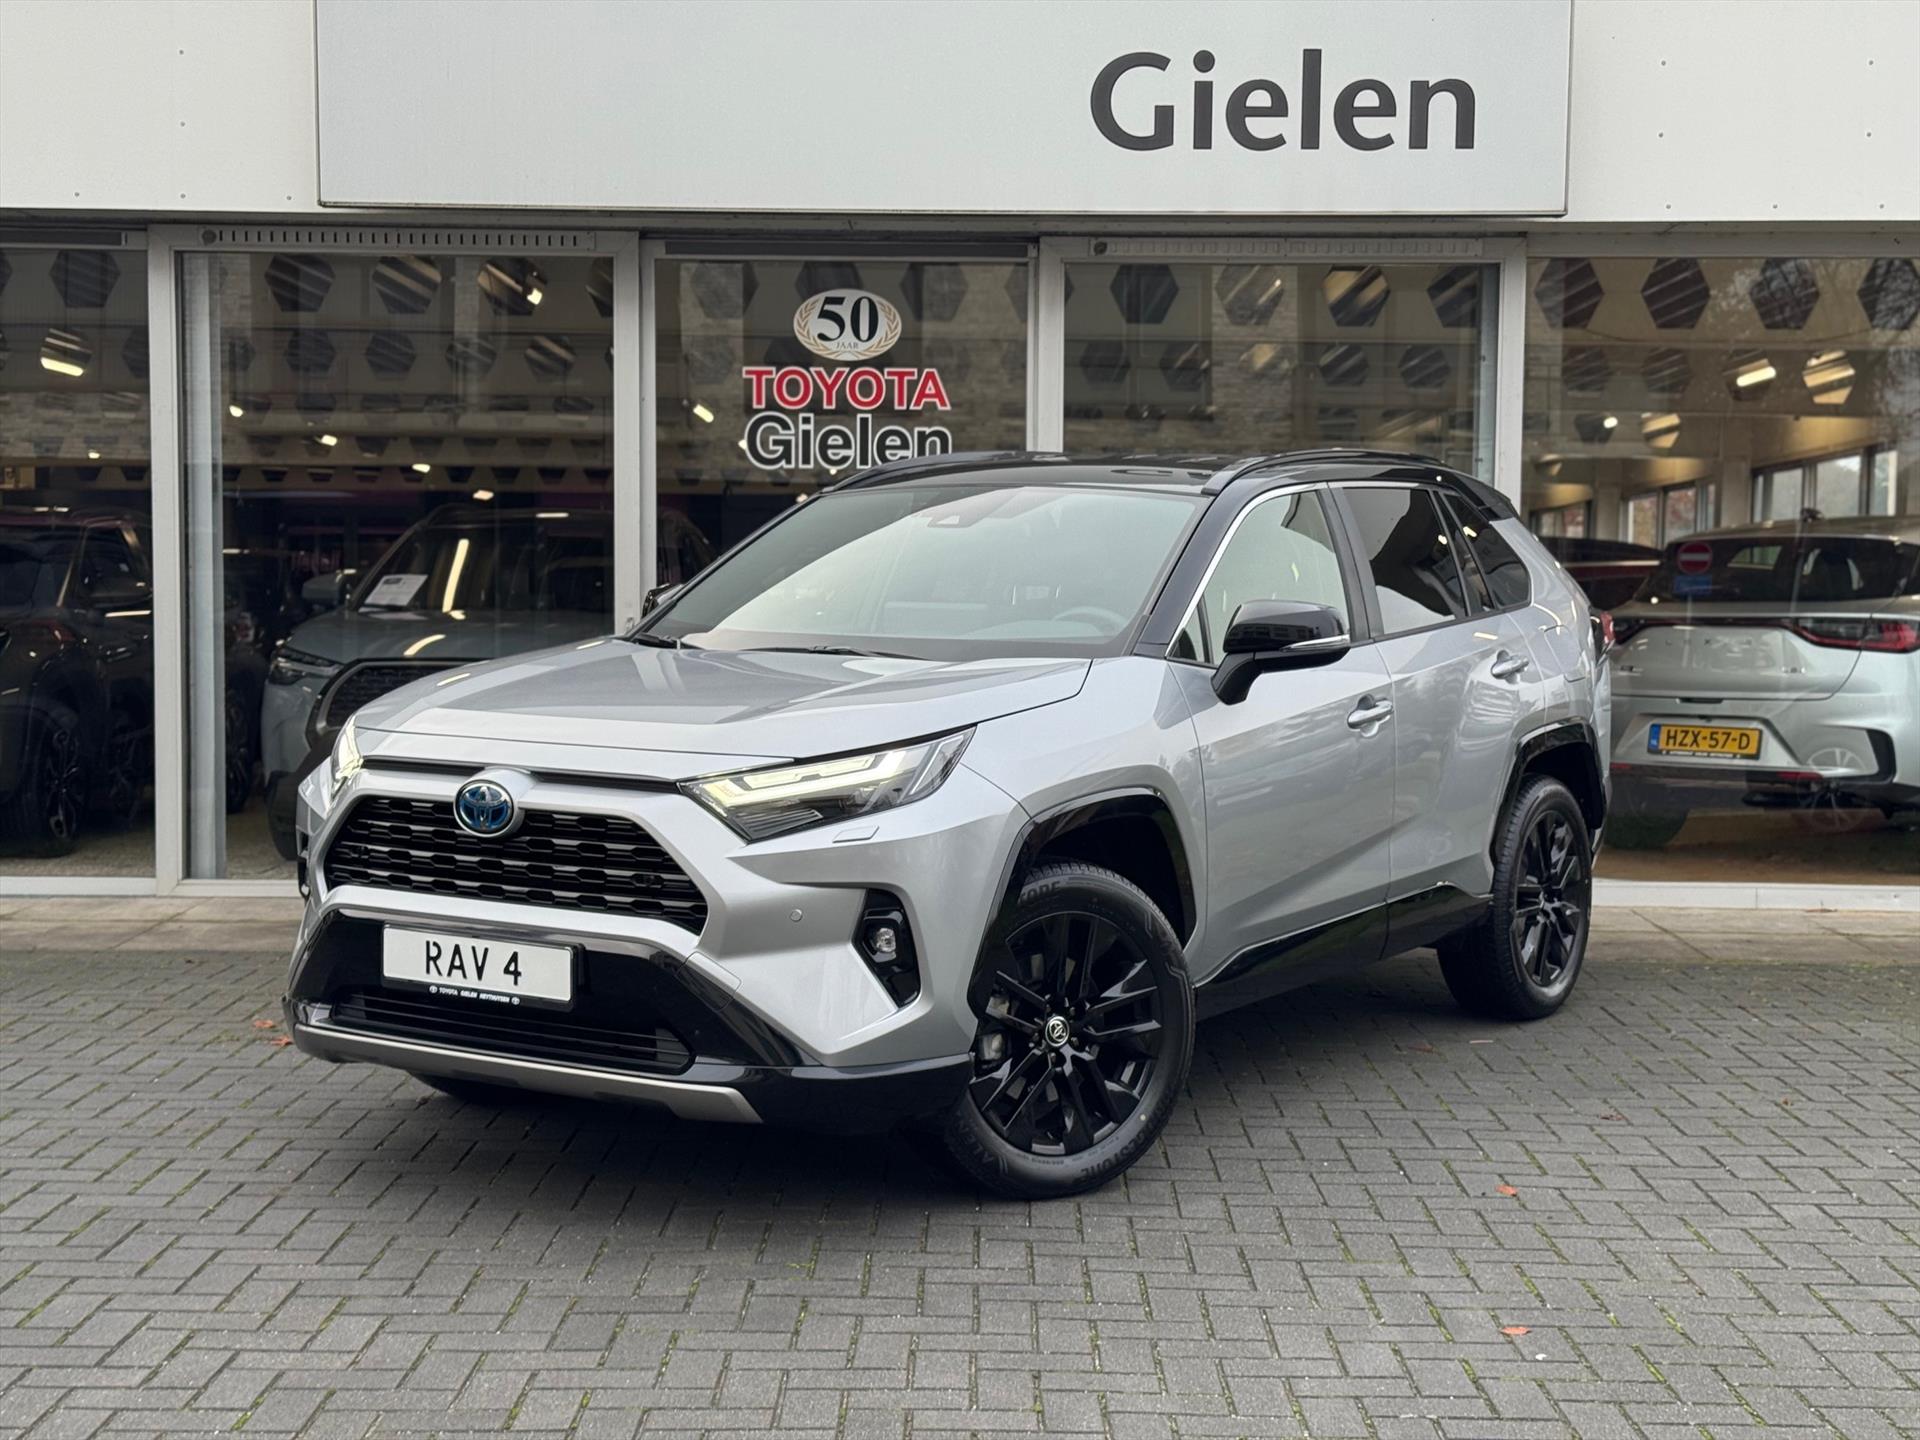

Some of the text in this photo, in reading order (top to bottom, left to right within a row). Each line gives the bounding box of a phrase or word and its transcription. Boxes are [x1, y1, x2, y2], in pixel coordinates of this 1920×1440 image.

[1090, 48, 1476, 151] Gielen
[817, 296, 879, 343] 50
[835, 342, 859, 350] JAAR
[743, 366, 951, 410] TOYOTA
[744, 411, 952, 470] Gielen
[1665, 729, 1751, 750] HZX-57-D
[426, 940, 522, 986] RAV 4
[439, 987, 458, 996] TOYOTA
